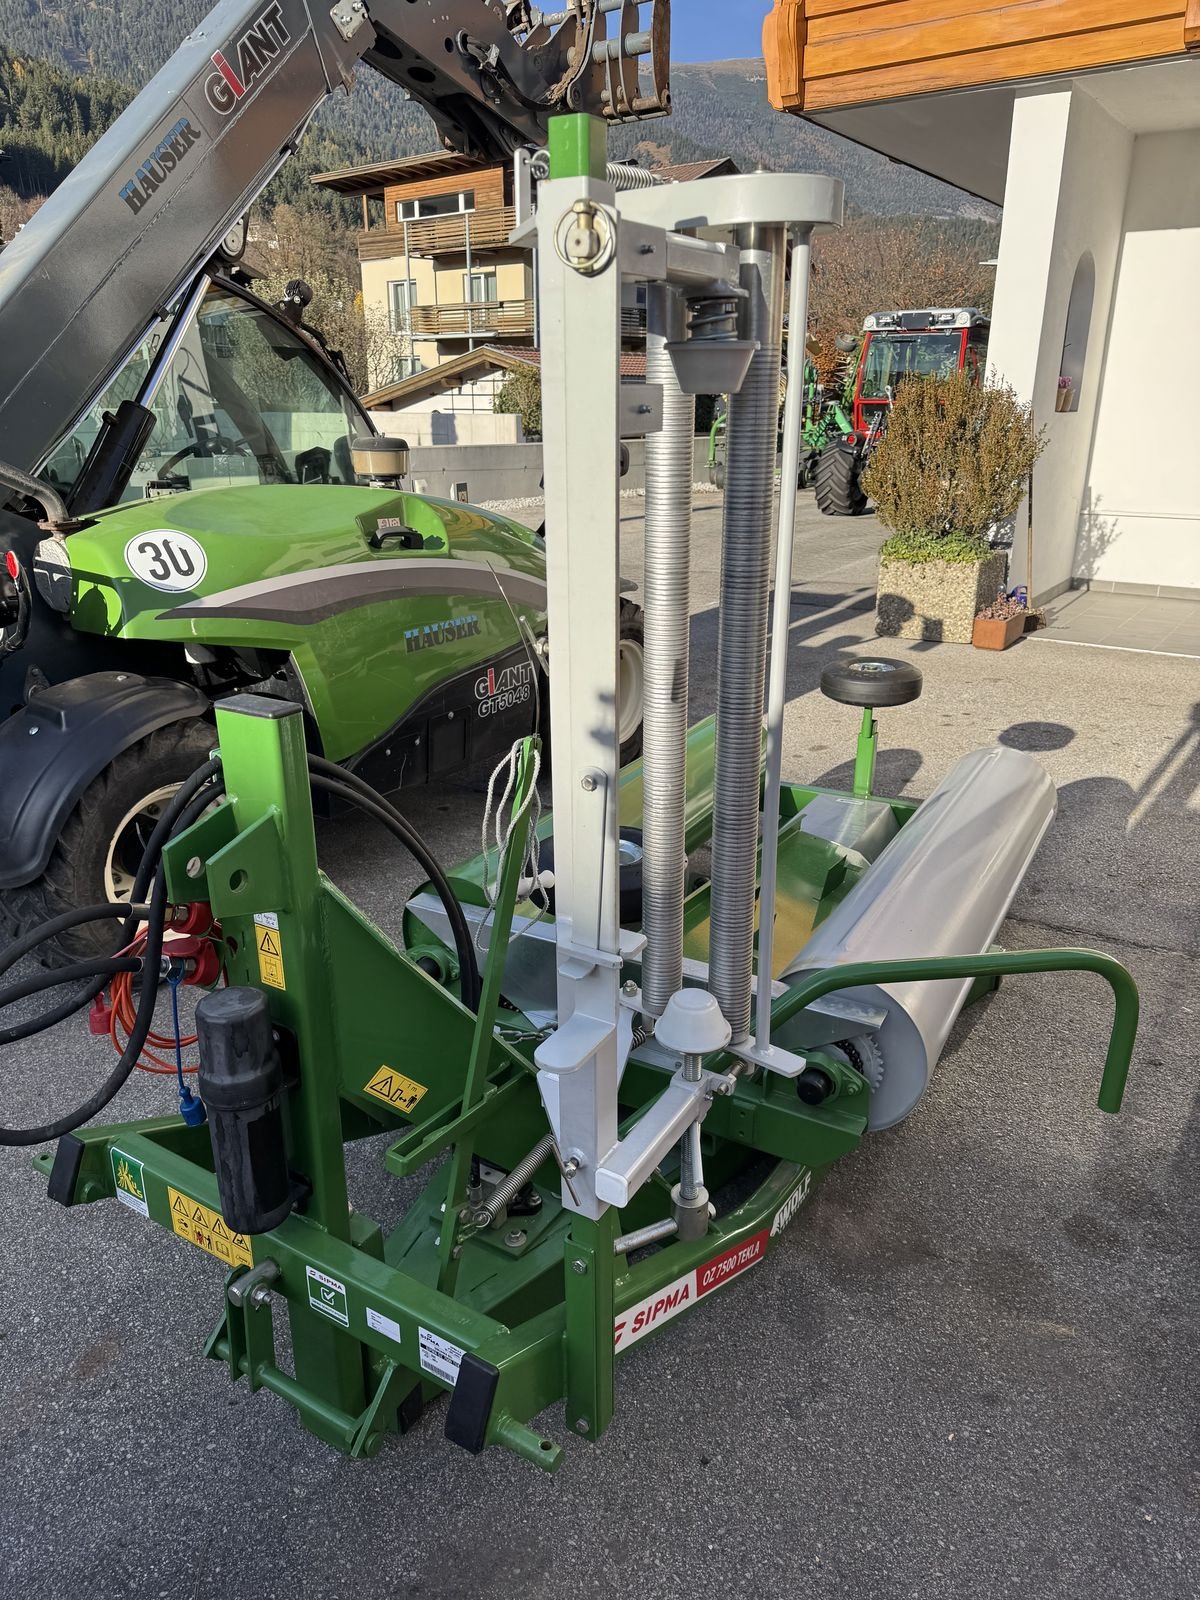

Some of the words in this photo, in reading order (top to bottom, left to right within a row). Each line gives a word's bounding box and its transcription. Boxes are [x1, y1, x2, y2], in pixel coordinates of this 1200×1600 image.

[119, 117, 201, 215] HAUSER
[138, 539, 195, 581] 30
[404, 615, 481, 654] HAUSER
[478, 684, 530, 717] GT5048
[318, 1274, 343, 1291] SIPMA
[631, 1283, 690, 1334] SIPMA
[702, 1268, 716, 1286] OZ
[716, 1255, 737, 1280] 7500
[737, 1241, 761, 1267] TEKLA
